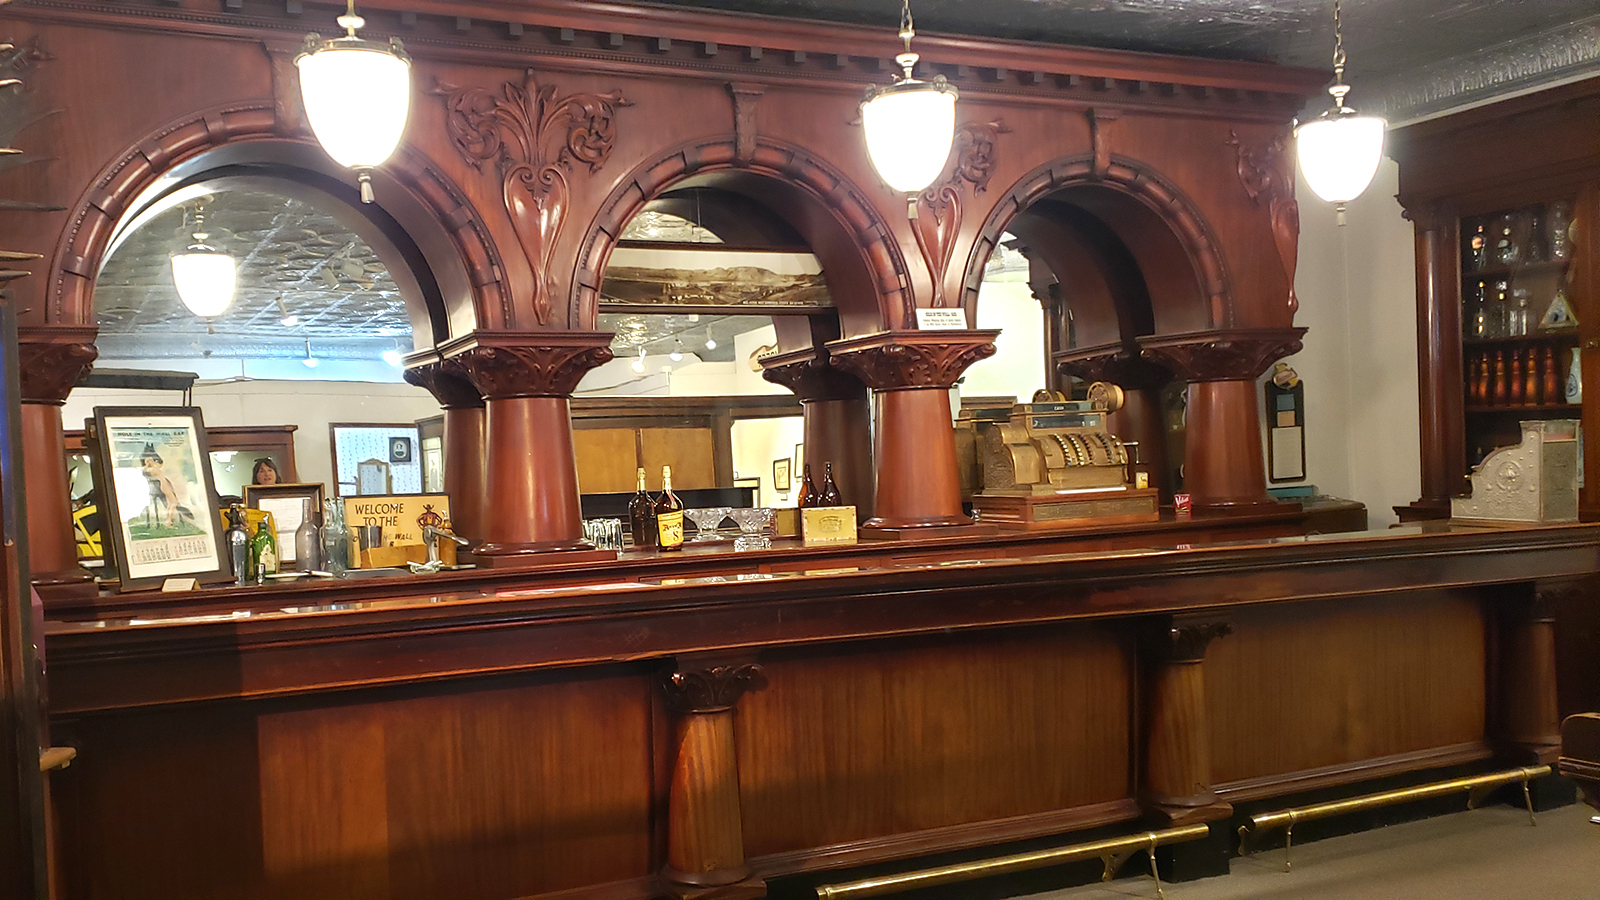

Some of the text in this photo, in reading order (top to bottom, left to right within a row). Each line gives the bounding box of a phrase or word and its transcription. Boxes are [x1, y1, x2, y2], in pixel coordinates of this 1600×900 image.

[355, 503, 404, 515] WELCOME
[363, 516, 398, 527] TO THE
[394, 532, 413, 541] WALL
